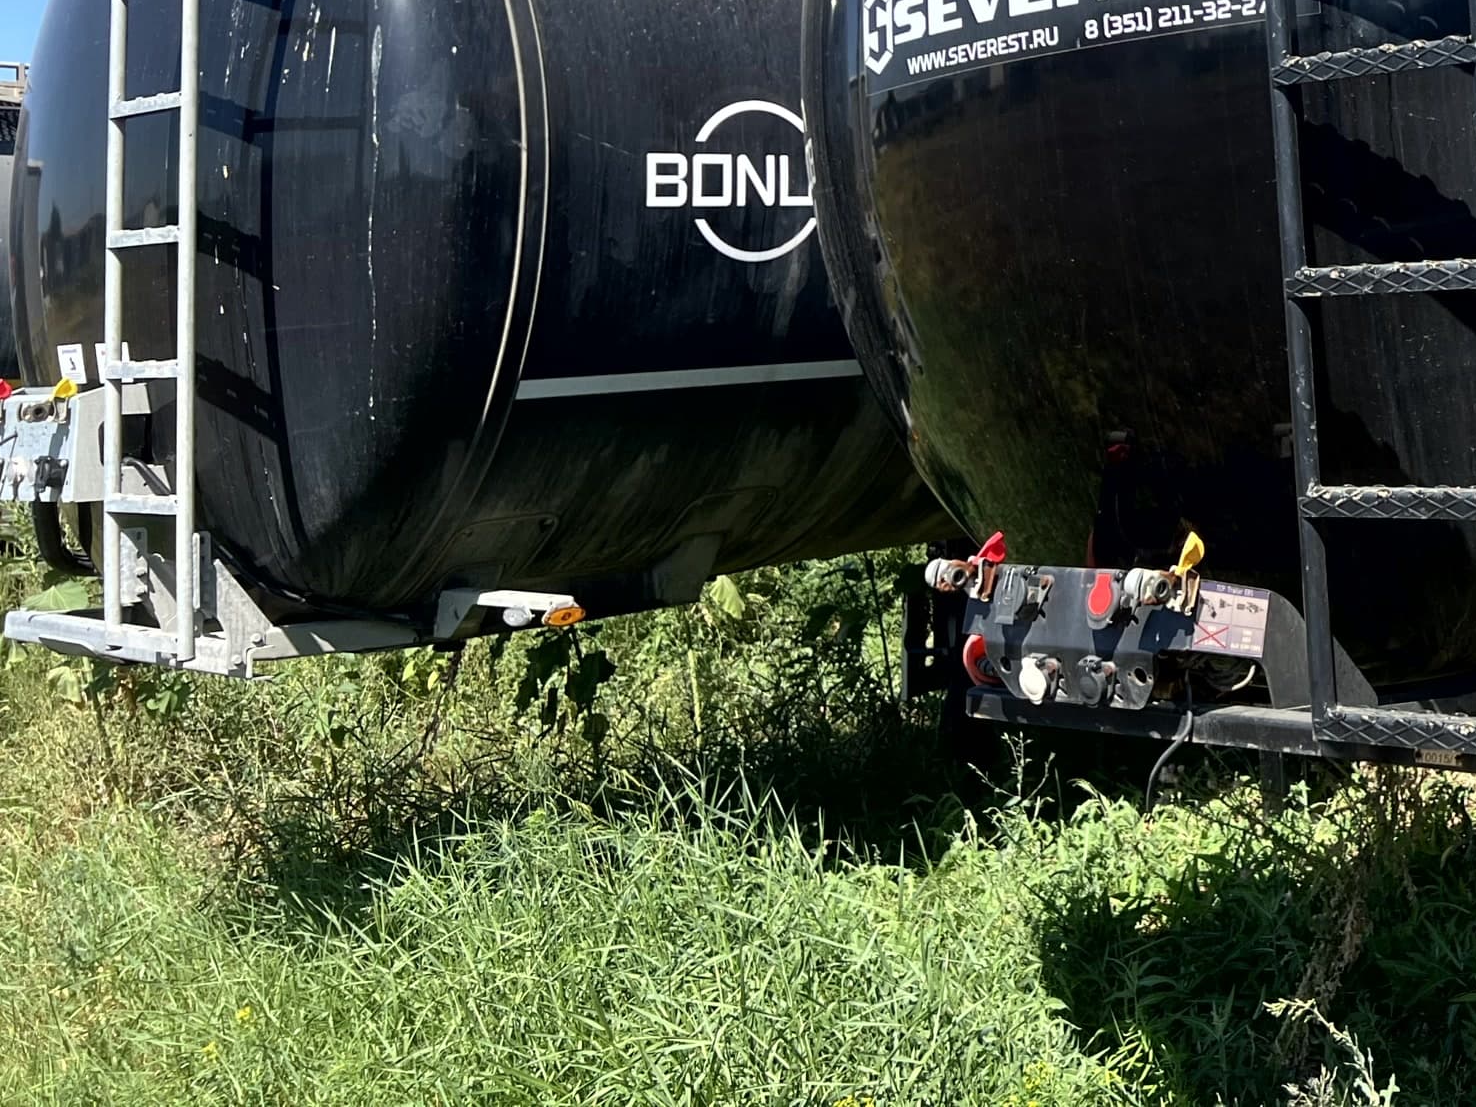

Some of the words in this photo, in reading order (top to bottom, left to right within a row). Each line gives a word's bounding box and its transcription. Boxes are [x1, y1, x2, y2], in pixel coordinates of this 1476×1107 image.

[907, 26, 1059, 75] WWW.SEVEREST.RU
[1085, 20, 1098, 40] 8
[1103, 7, 1153, 39] (351)
